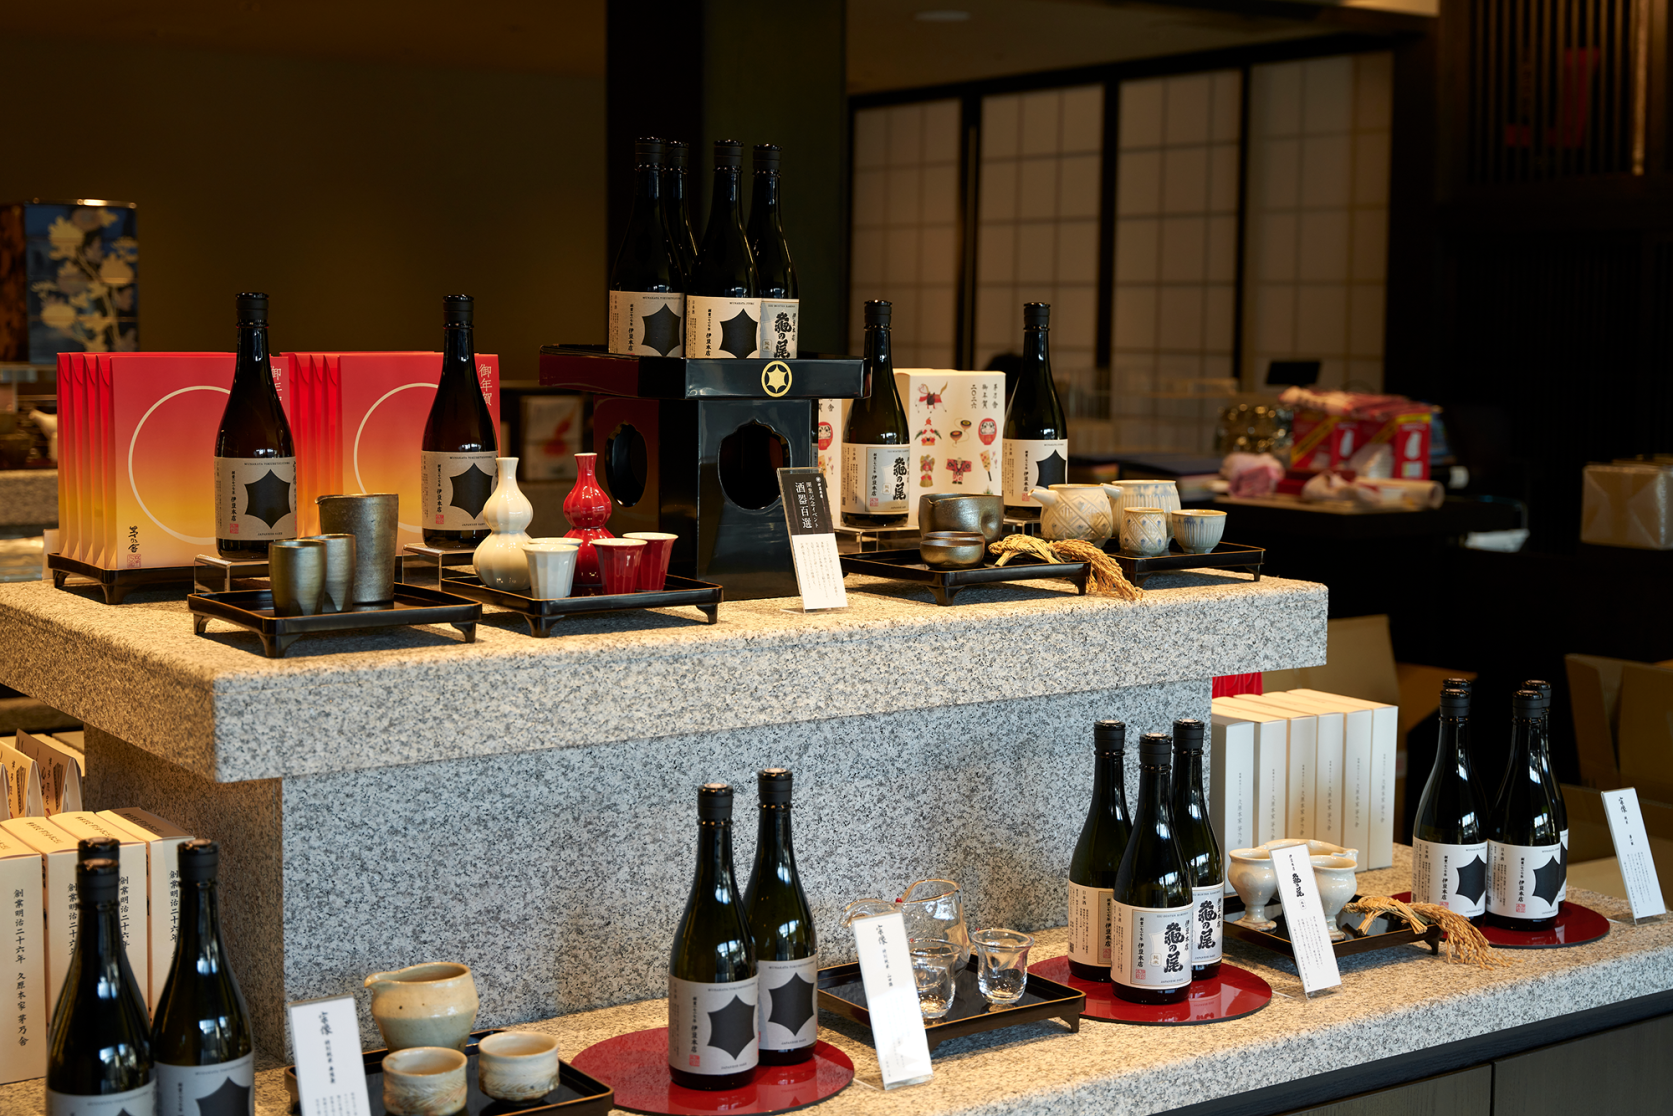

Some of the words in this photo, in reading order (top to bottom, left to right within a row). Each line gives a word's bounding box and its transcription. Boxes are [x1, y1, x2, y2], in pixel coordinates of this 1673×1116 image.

[478, 364, 492, 406] 御年賀
[795, 482, 812, 528] 酒器百選
[14, 889, 25, 964] 創業明治二十六年
[17, 972, 26, 1012] 久原本家
[18, 1014, 28, 1046] 茅乃舎
